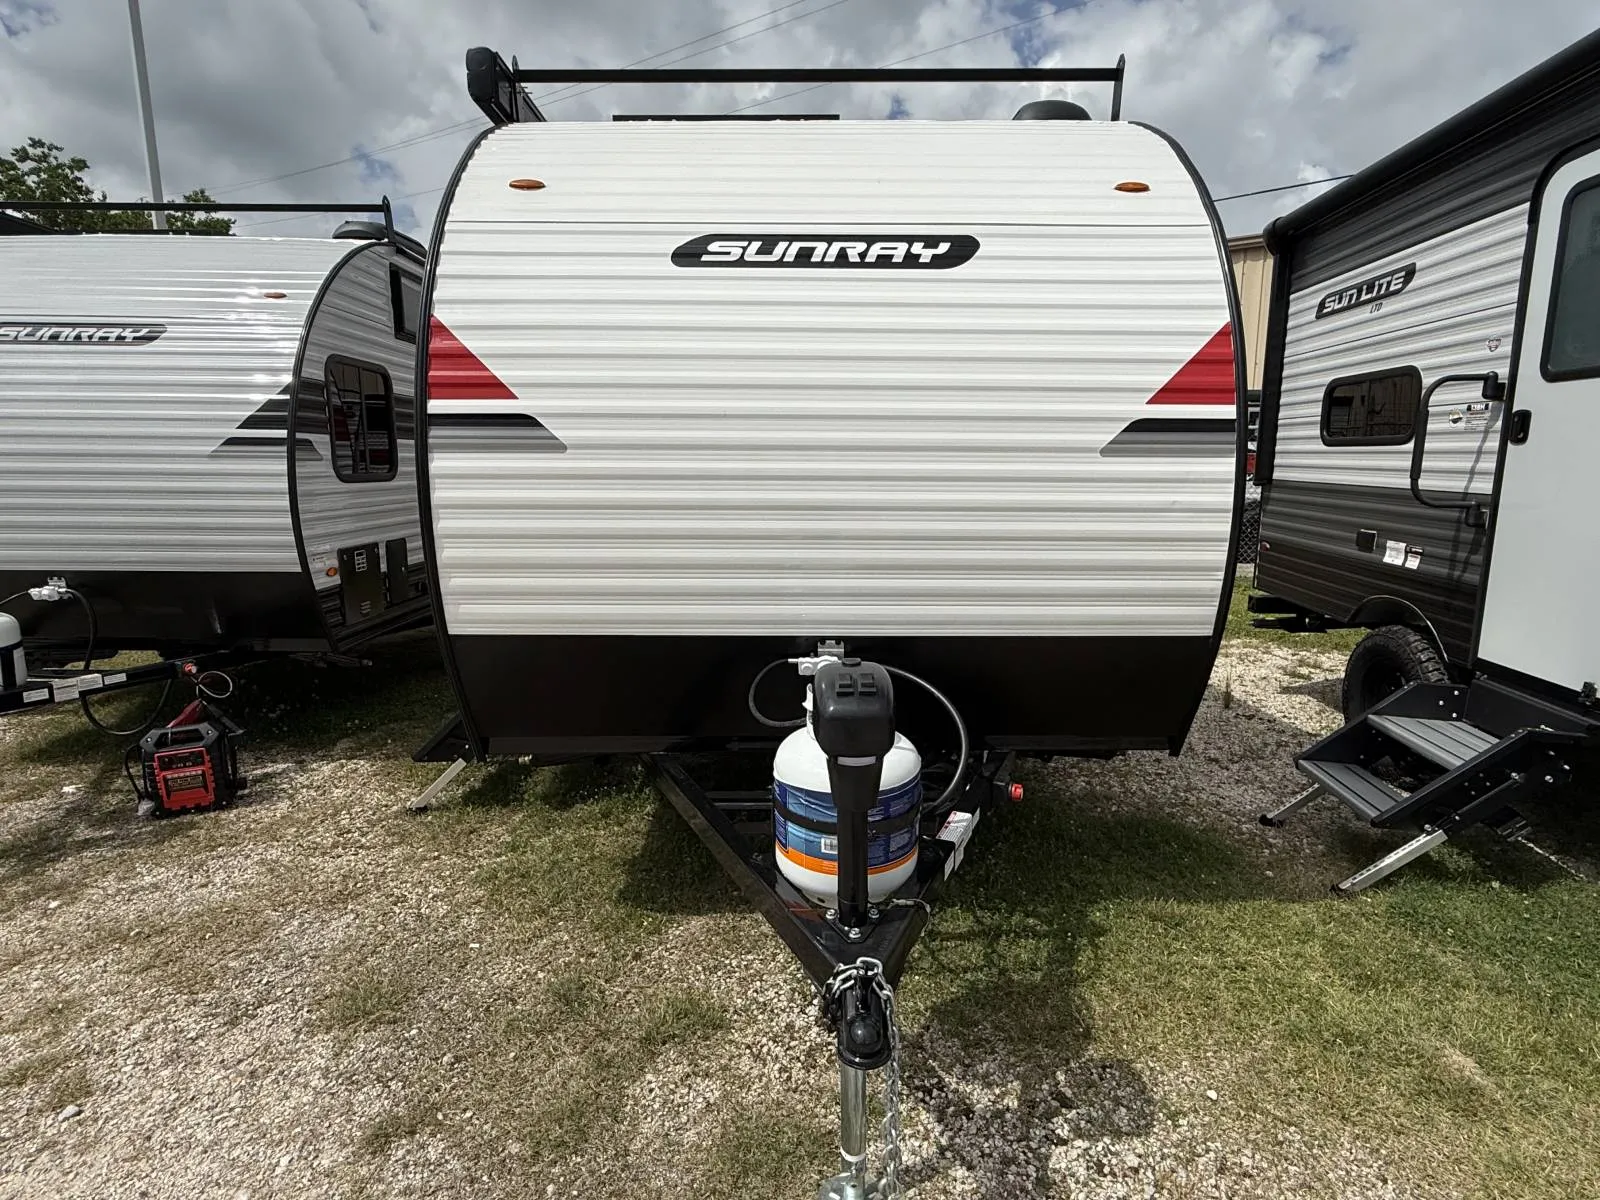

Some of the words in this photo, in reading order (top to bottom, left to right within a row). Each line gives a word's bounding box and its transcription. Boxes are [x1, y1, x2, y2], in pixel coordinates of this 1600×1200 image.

[700, 240, 952, 263] SUNRAY
[1322, 288, 1358, 314] SUN
[1360, 271, 1406, 302] LITE
[1369, 302, 1384, 314] LTD
[0, 326, 150, 342] SUNRAY
